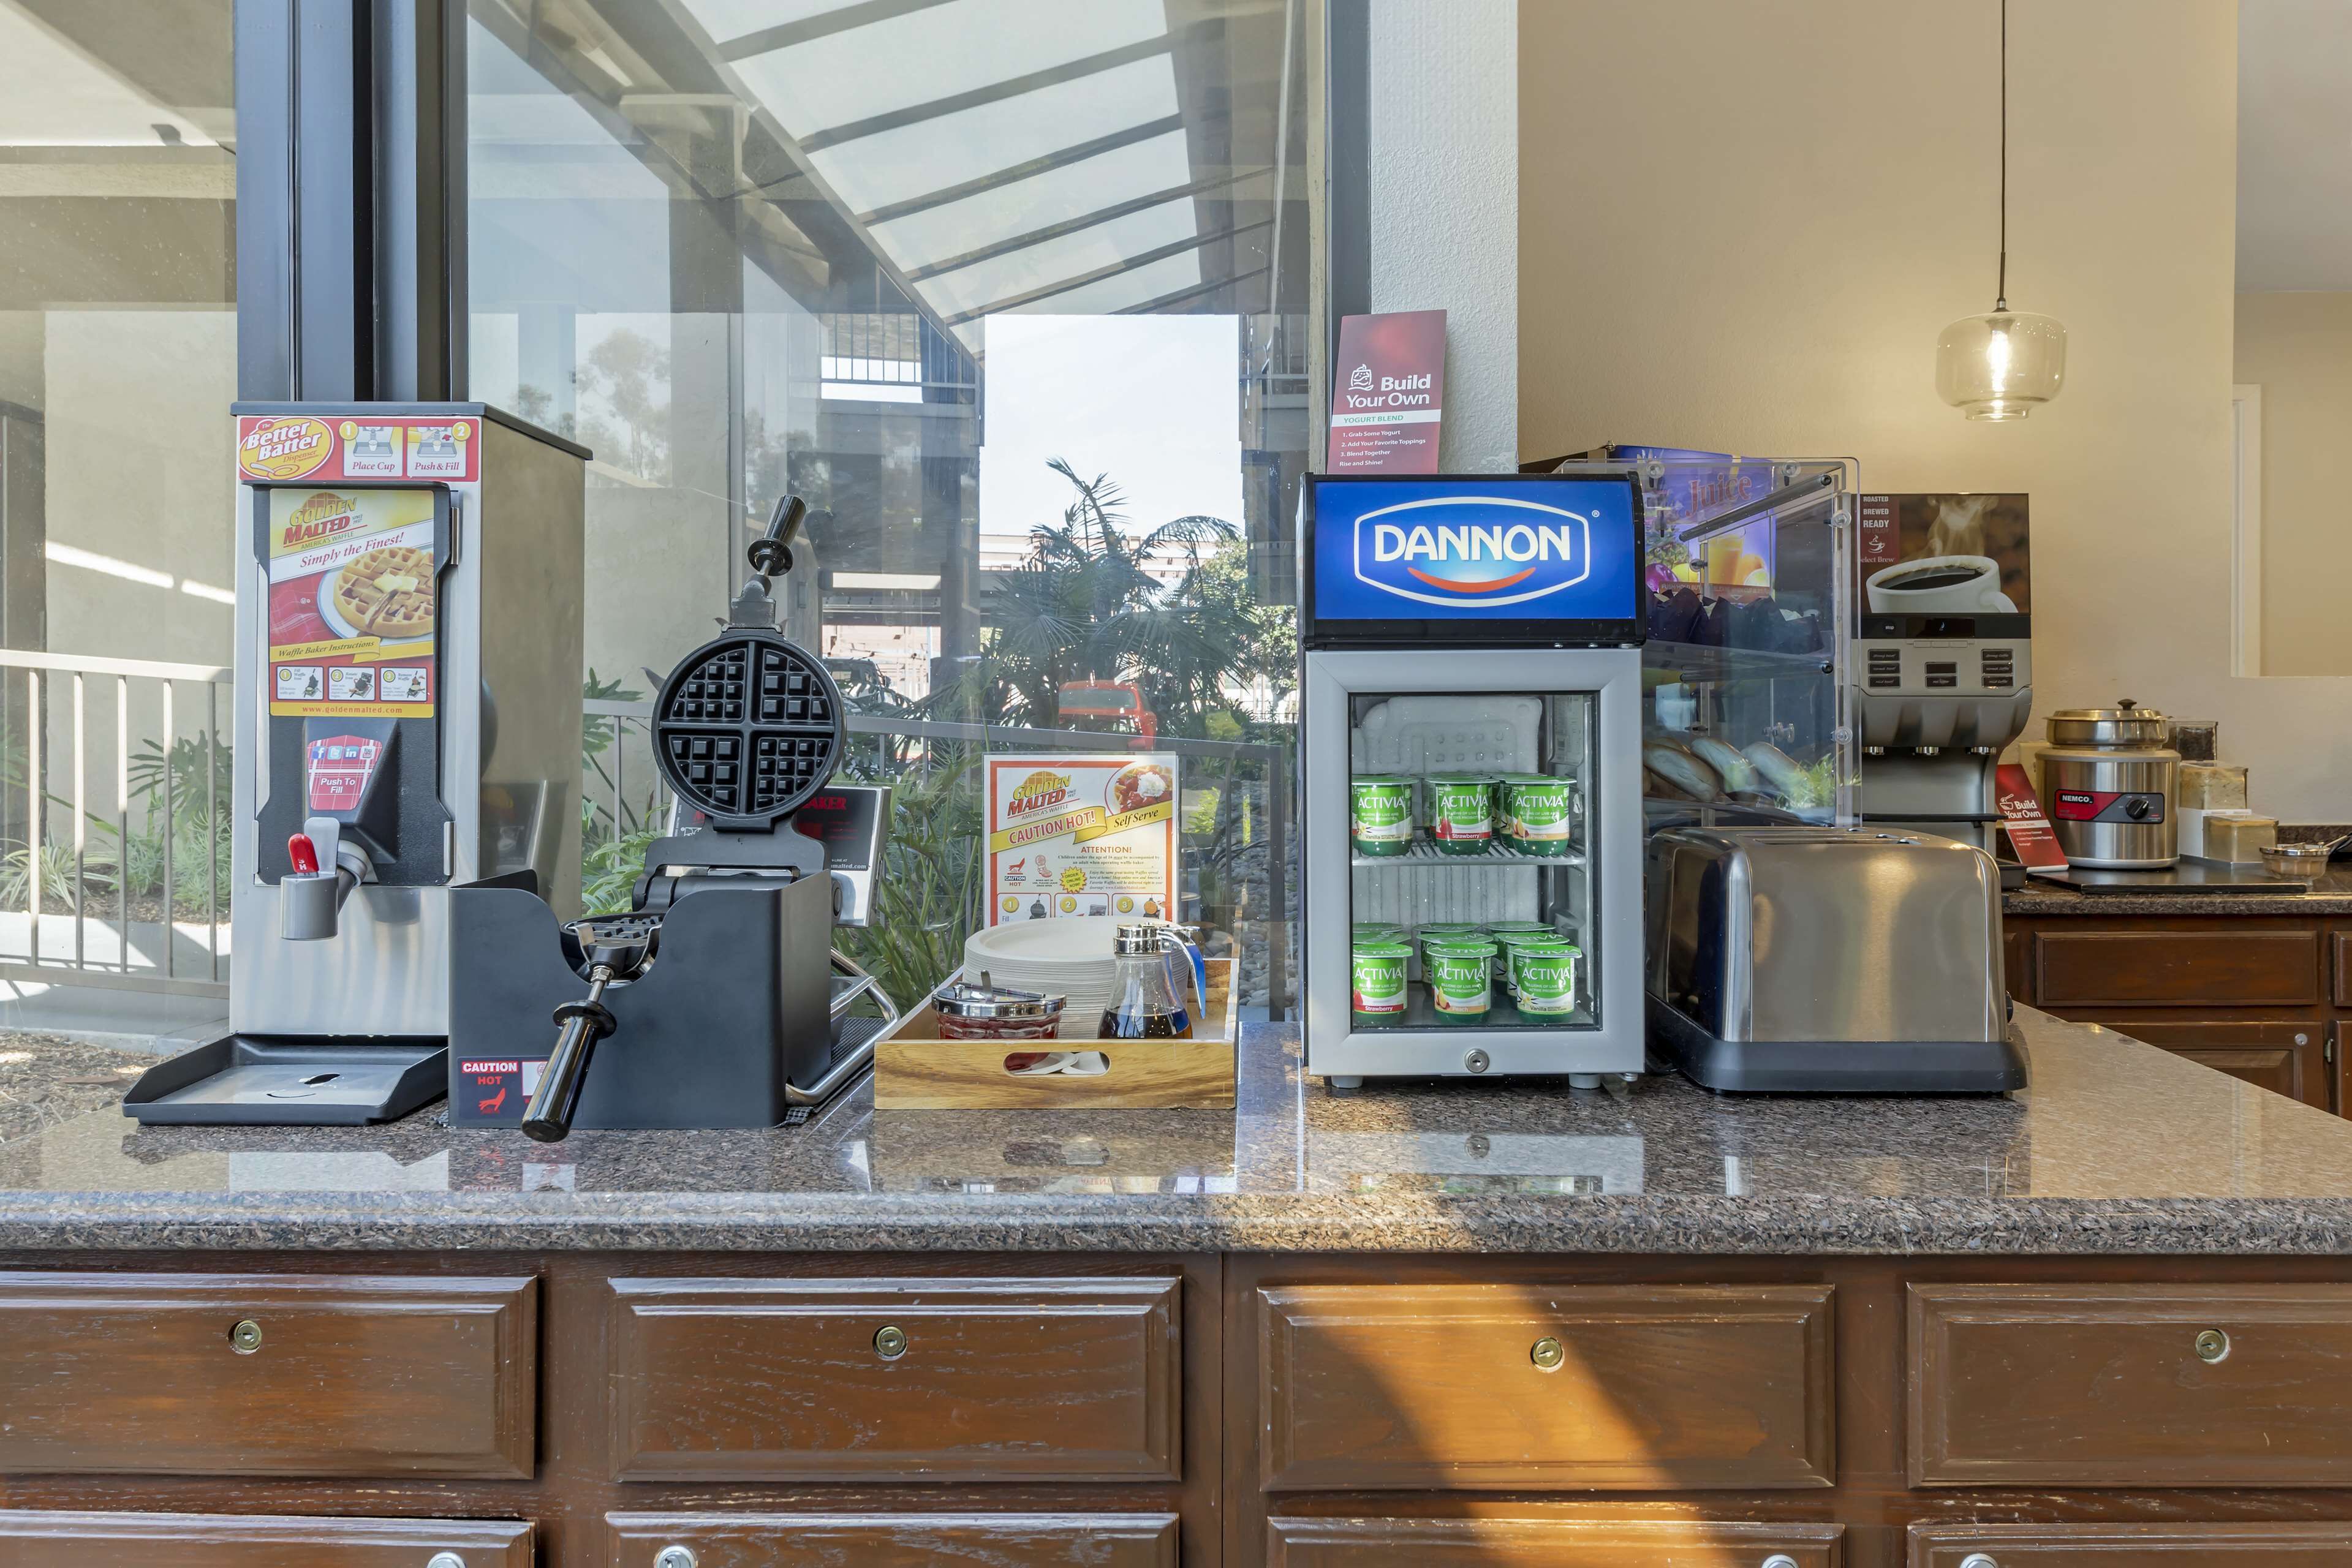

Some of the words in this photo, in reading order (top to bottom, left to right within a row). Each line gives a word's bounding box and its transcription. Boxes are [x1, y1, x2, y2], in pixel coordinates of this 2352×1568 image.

[1381, 374, 1431, 391] Build
[1346, 394, 1386, 408] Your
[1388, 392, 1430, 405] Own
[246, 421, 311, 450] Better
[346, 425, 351, 435] 1
[456, 426, 465, 436] 2
[257, 432, 322, 461] Batter
[283, 450, 317, 462] Dispenser
[352, 462, 375, 470] Place
[377, 462, 395, 472] Cup
[415, 462, 436, 470] Push
[445, 462, 459, 470] Fill
[1686, 472, 1752, 518] Juice
[289, 497, 358, 527] GOLDEN
[283, 515, 350, 545] MALTED
[300, 537, 331, 550] AMERICA'S
[331, 531, 354, 541] WAFFLE
[1374, 524, 1571, 562] DANNON
[300, 549, 341, 569] Simply
[344, 545, 362, 557] the
[365, 532, 404, 551] Finest!
[279, 649, 303, 658] Waffle
[305, 646, 328, 654] Baker
[329, 641, 374, 652] Instructions
[302, 706, 403, 715] www.goldenmalted.com
[345, 748, 357, 758] in
[1013, 774, 1072, 801] GOLDEN
[803, 795, 847, 810] AKER
[1007, 788, 1067, 816] MALTED
[1358, 796, 1405, 809] ACTIVIA
[1440, 795, 1489, 808] ACTIVIA
[1515, 795, 1564, 807] ACTIVIA
[2014, 799, 2037, 810] Build
[1021, 809, 1048, 820] AMERICA'S
[1049, 804, 1069, 813] WAFFLE
[1114, 813, 1133, 828] Self
[1133, 809, 1159, 823] Serve
[2005, 810, 2022, 819] Your
[1008, 819, 1064, 844] CAUTION
[1066, 810, 1095, 829] HOT!
[1355, 967, 1402, 980] ACTIVIA
[1437, 967, 1485, 980] ACTIVIA
[1522, 967, 1570, 981] ACTIVIA
[463, 1063, 517, 1072] CAUTION
[478, 1076, 502, 1085] HOT
